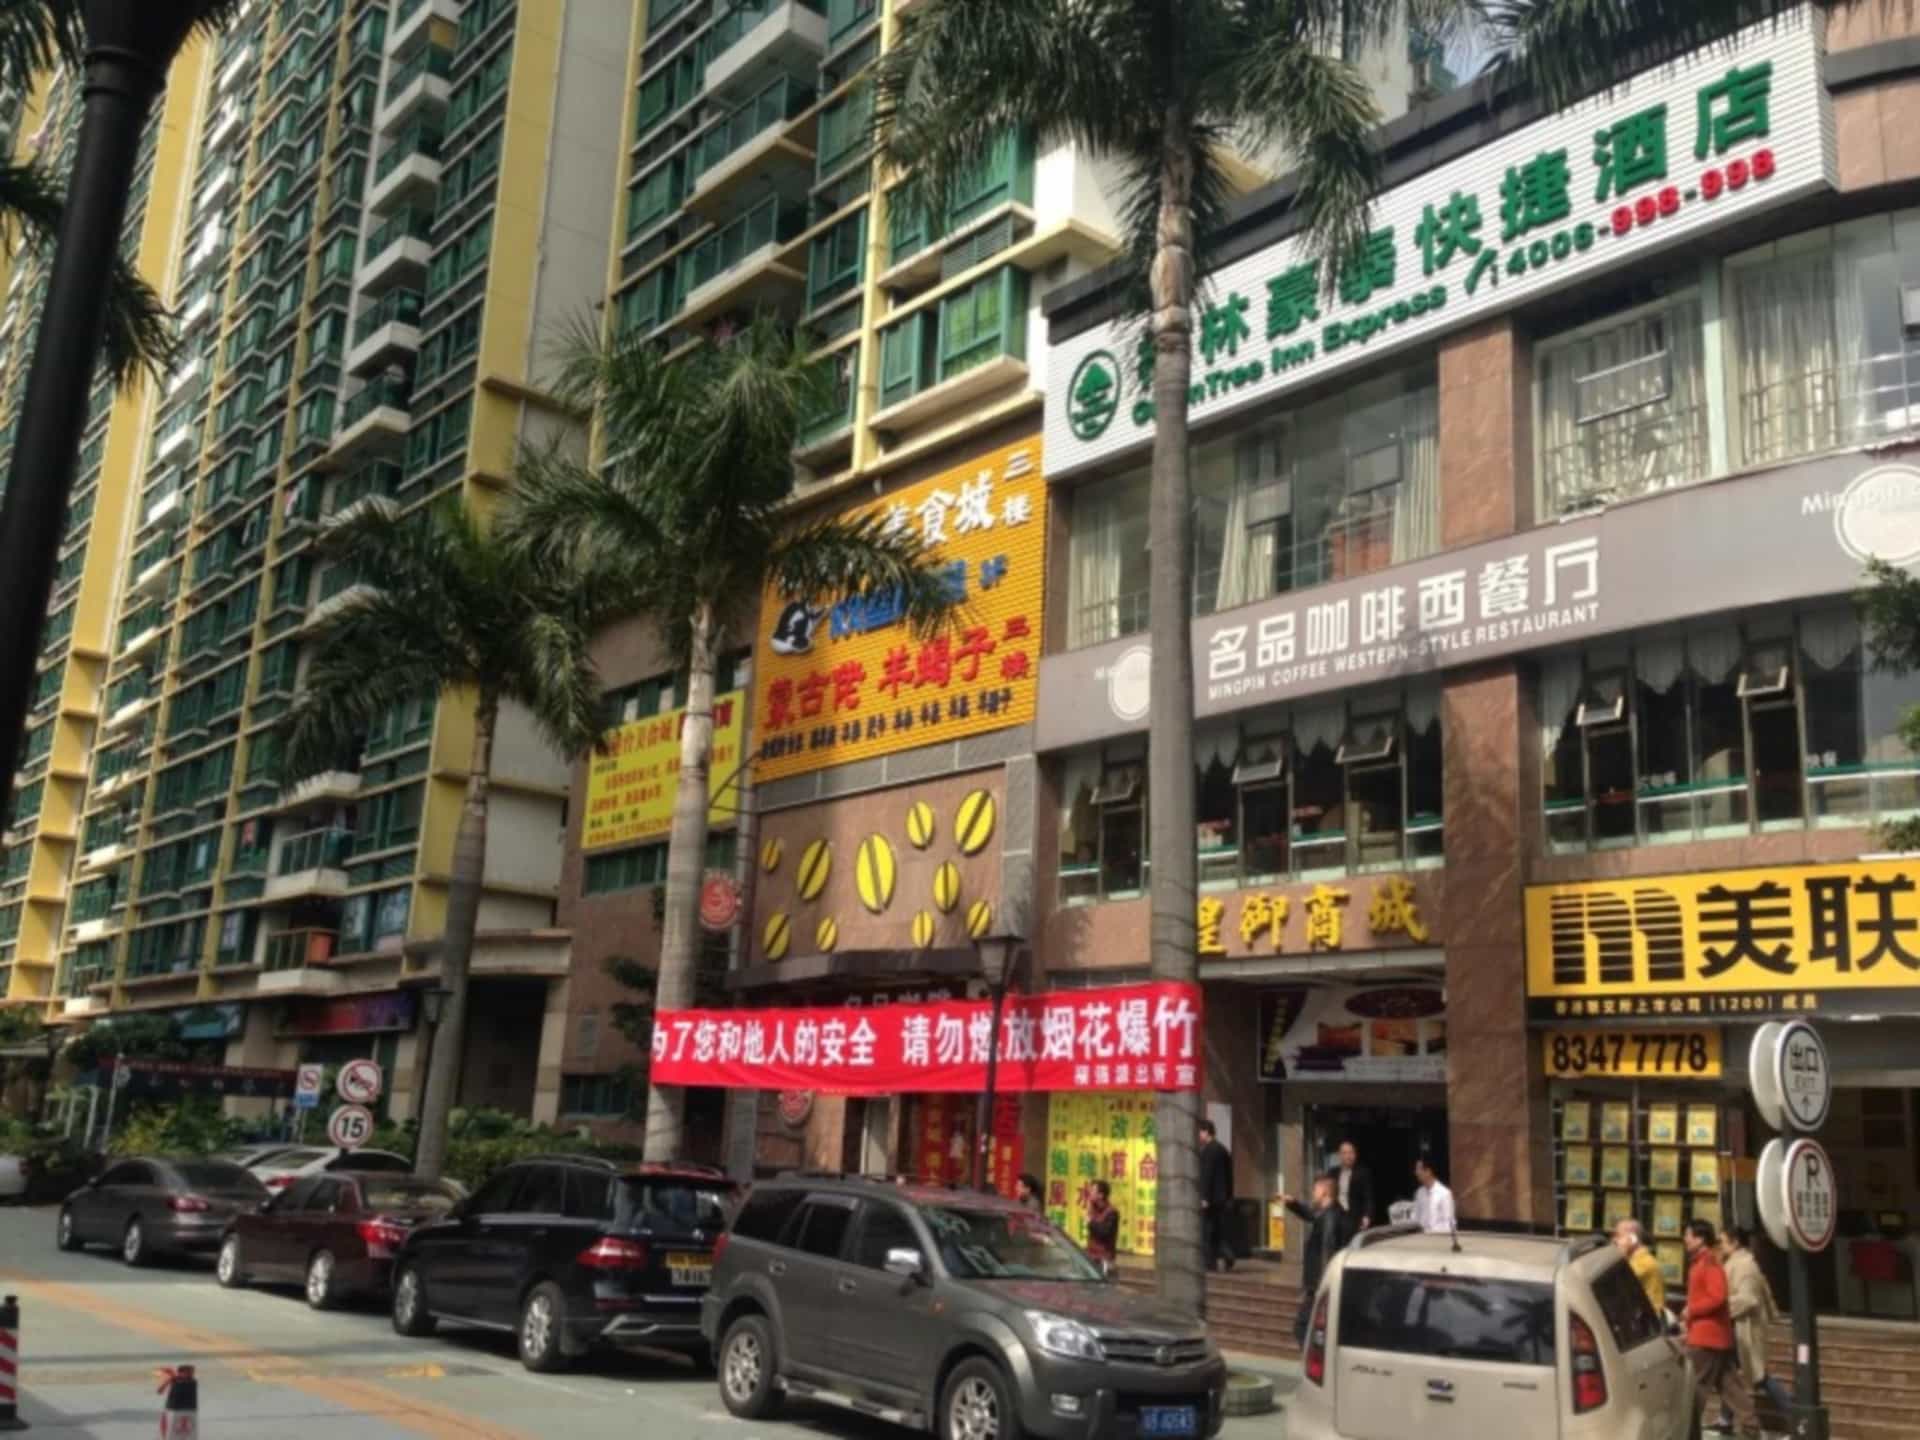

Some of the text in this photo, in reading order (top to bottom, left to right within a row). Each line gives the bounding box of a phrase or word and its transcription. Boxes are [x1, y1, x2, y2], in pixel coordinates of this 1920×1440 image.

[1271, 338, 1317, 376] Inn
[1322, 285, 1449, 353] Express
[1208, 536, 1599, 682] 名品咖啡西餐厅
[1208, 674, 1266, 701] MINGPIN
[1271, 660, 1328, 687] COFFEE
[1475, 601, 1600, 645] RESTAURANT
[652, 1016, 877, 1067] 为了您和他人的安全
[901, 995, 1198, 1066] 请勿燃放烟花爆竹
[341, 1117, 366, 1139] 15
